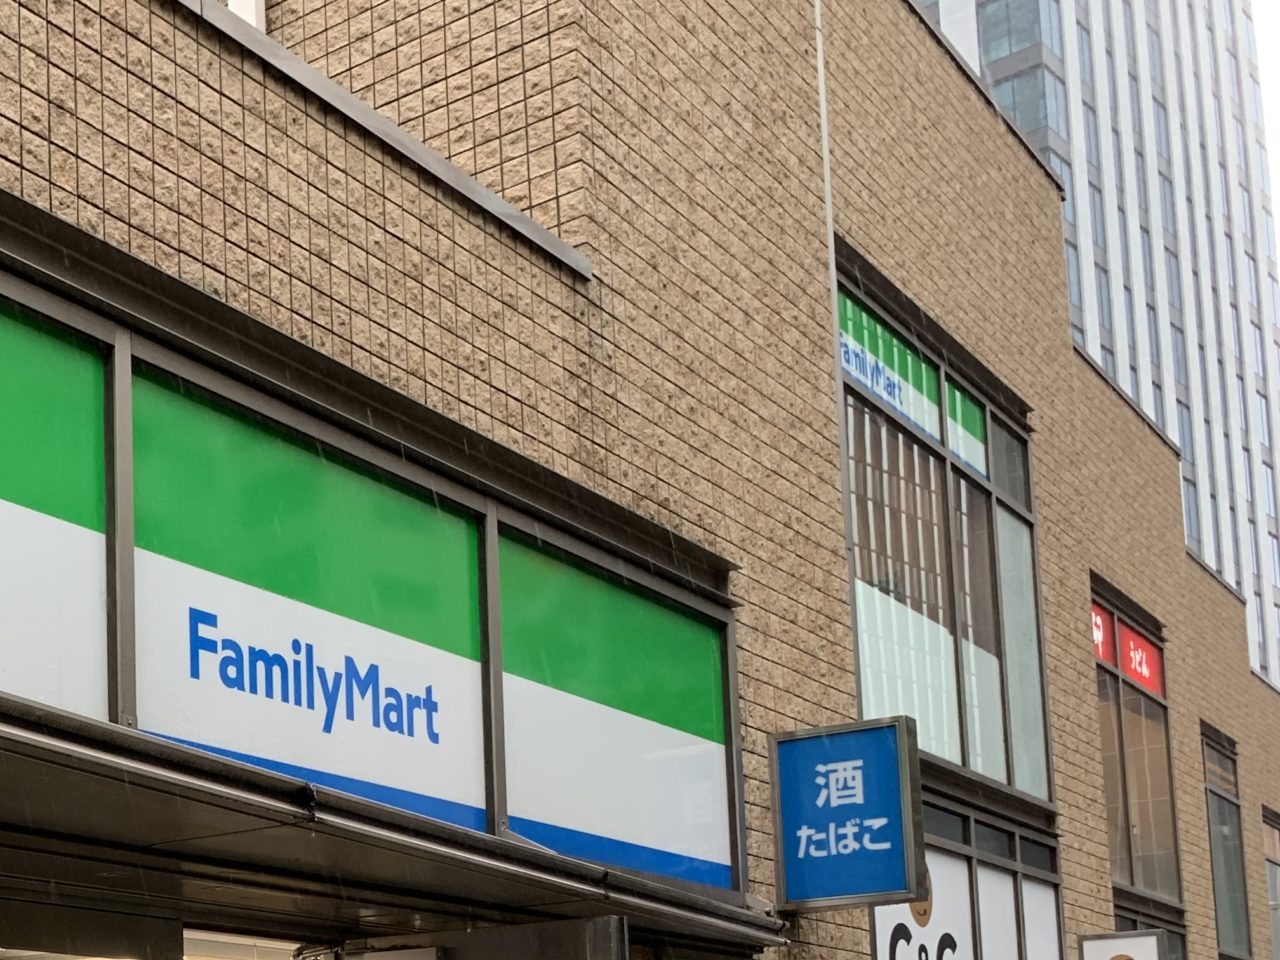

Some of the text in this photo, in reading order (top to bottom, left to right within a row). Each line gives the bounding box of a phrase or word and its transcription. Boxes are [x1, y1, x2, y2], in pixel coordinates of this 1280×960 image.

[840, 332, 903, 406] amilyMart
[189, 606, 439, 744] FamilyMart
[815, 759, 865, 808] 酒
[796, 817, 892, 858] たばこ
